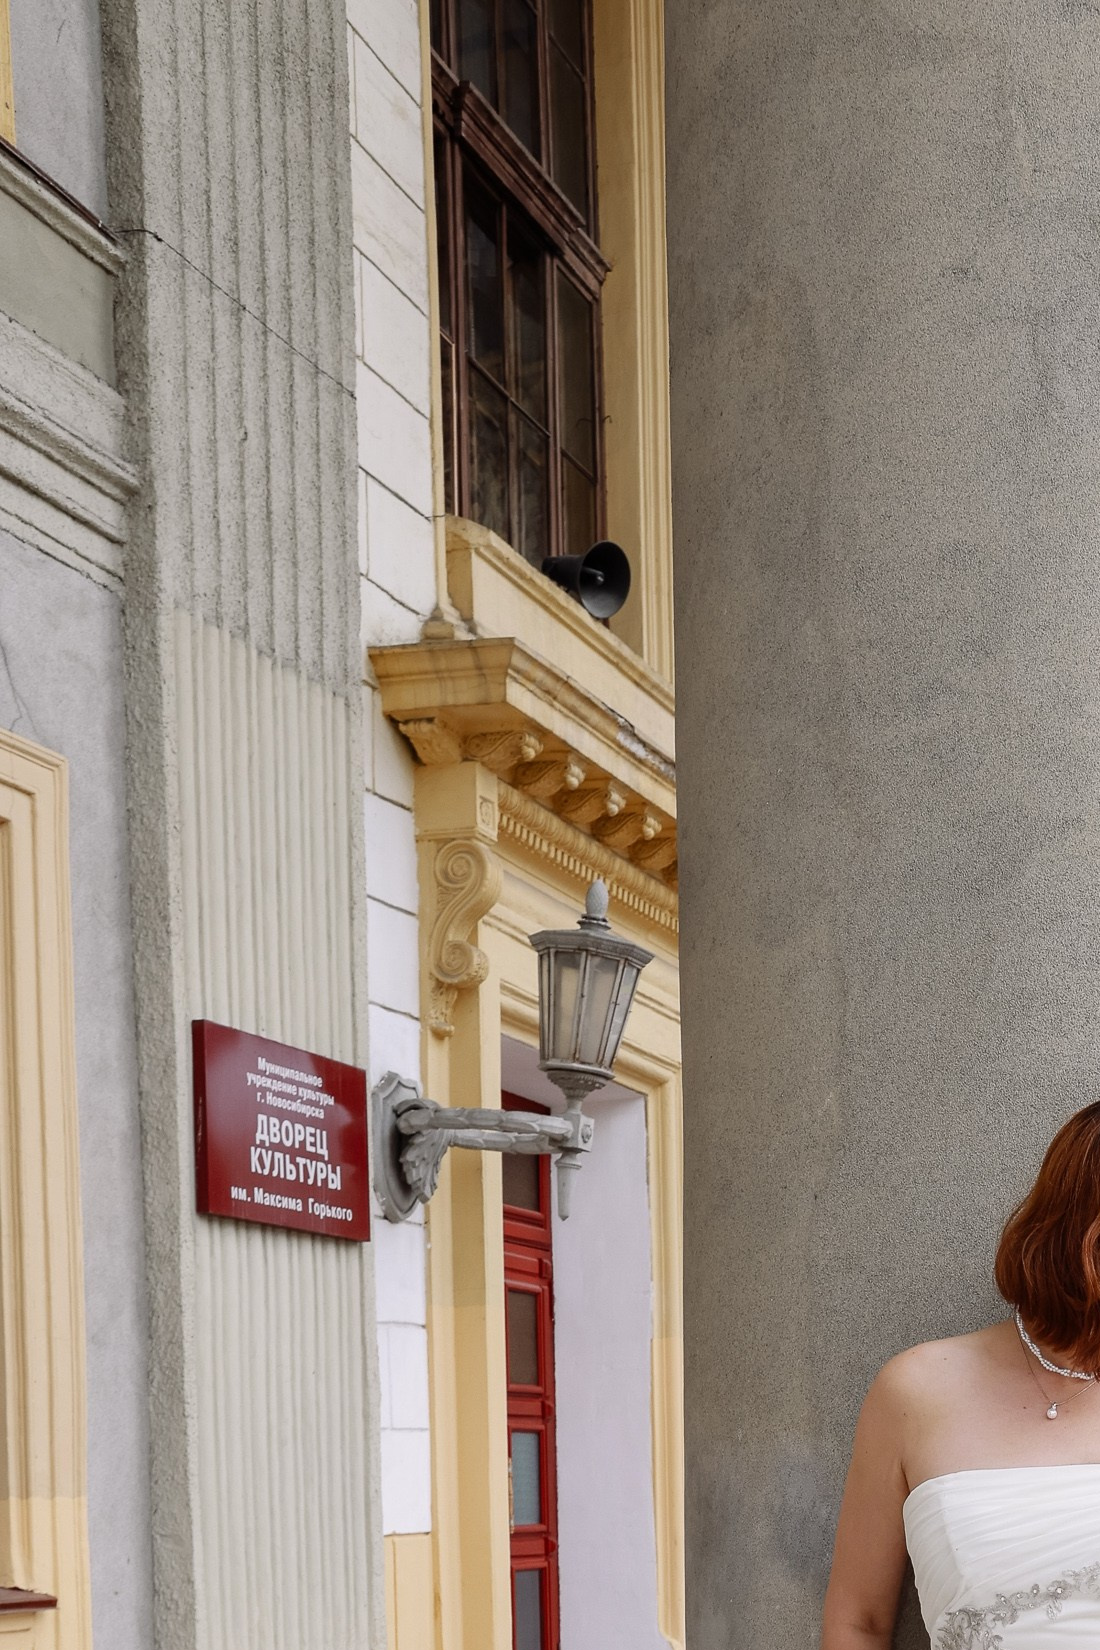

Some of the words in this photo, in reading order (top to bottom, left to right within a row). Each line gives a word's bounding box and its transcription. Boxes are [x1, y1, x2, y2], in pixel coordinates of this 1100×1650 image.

[247, 1073, 297, 1095] учреждение
[299, 1087, 334, 1106] культуры
[258, 1057, 323, 1088] Муниципальное
[257, 1093, 264, 1103] г.
[266, 1094, 325, 1119] Новосибирска
[256, 1114, 328, 1160] ДВОРЕЦ
[250, 1147, 341, 1191] КУЛЬТУРЫ
[231, 1186, 251, 1202] им.
[254, 1187, 303, 1212] Максима
[308, 1198, 353, 1222] Горького
